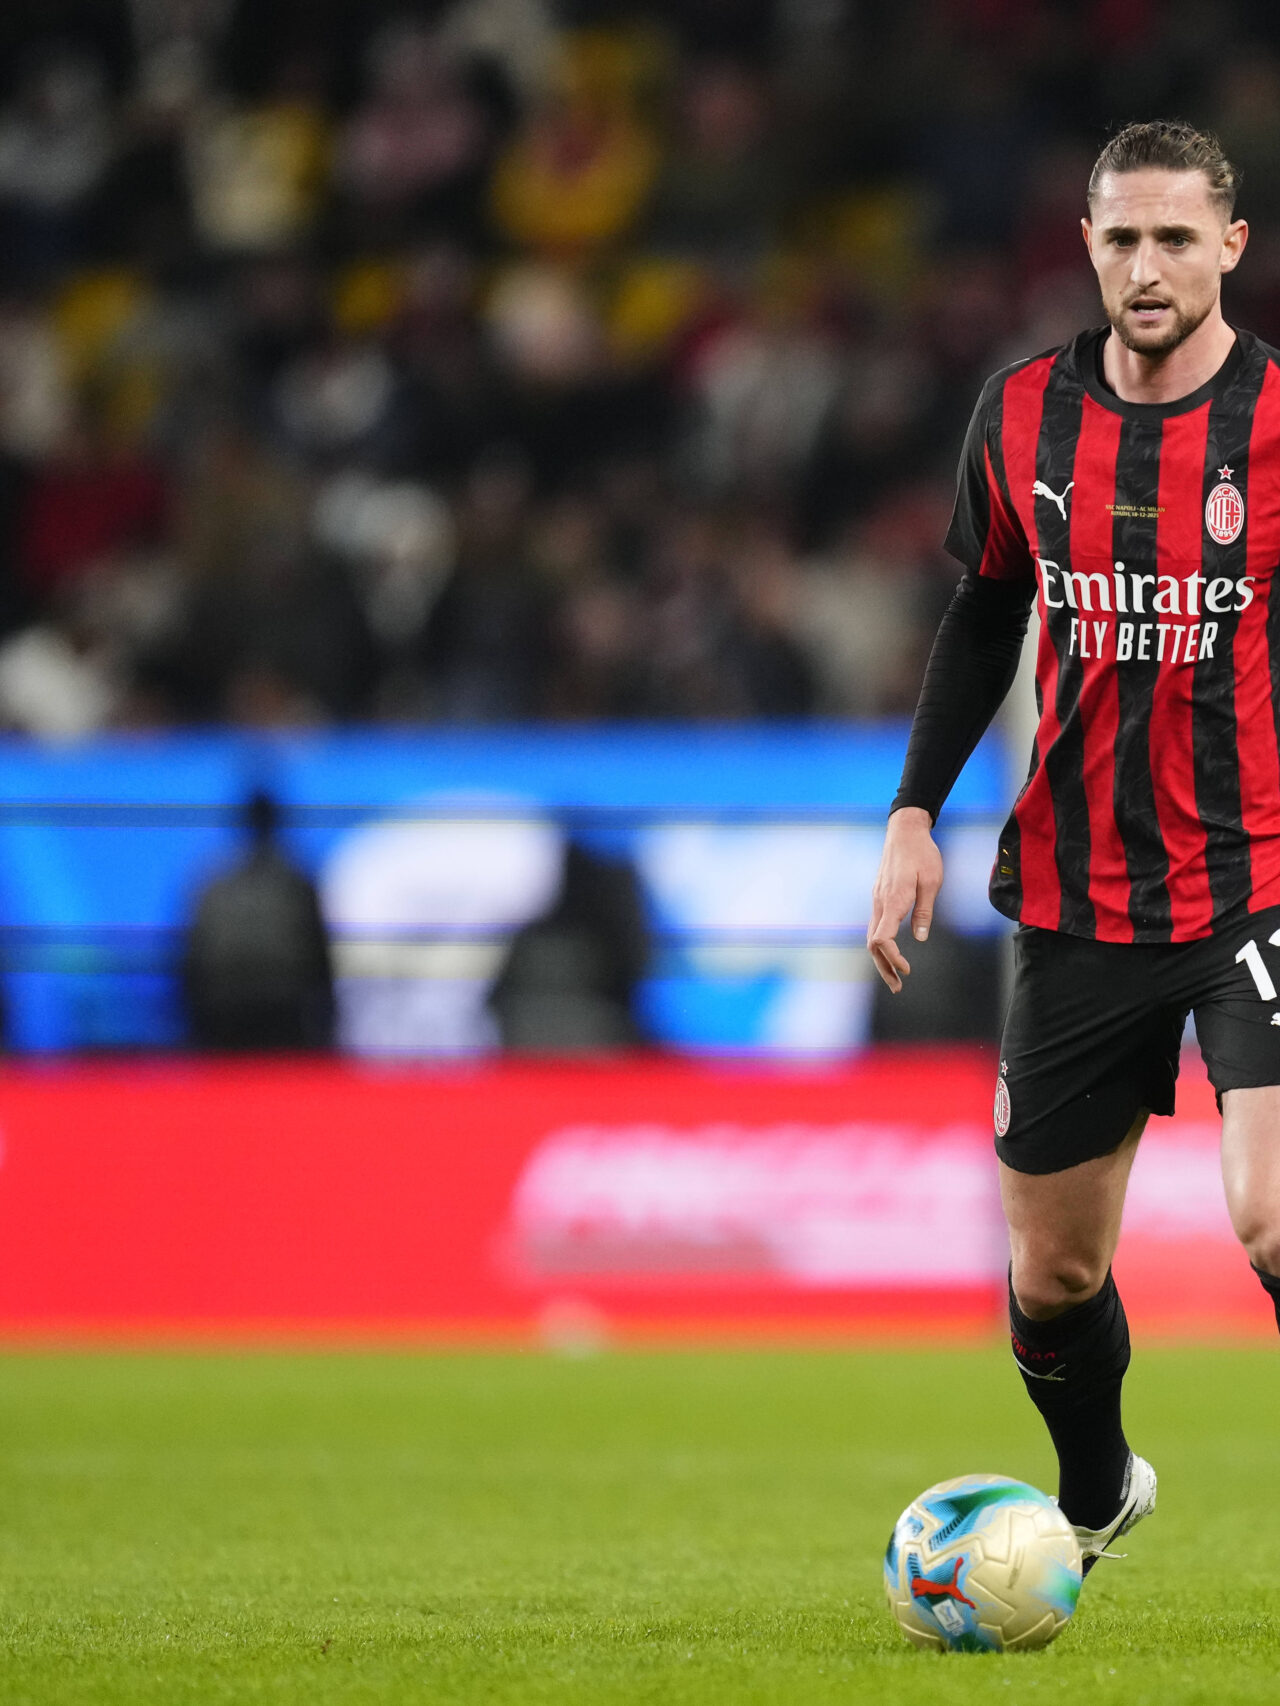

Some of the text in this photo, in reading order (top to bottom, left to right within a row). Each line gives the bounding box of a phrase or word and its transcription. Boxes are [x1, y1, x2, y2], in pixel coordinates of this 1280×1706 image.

[1216, 488, 1236, 500] ACM
[1216, 529, 1234, 537] 1899
[1036, 557, 1256, 616] Emirates
[1069, 617, 1219, 664] FLY BETTER
